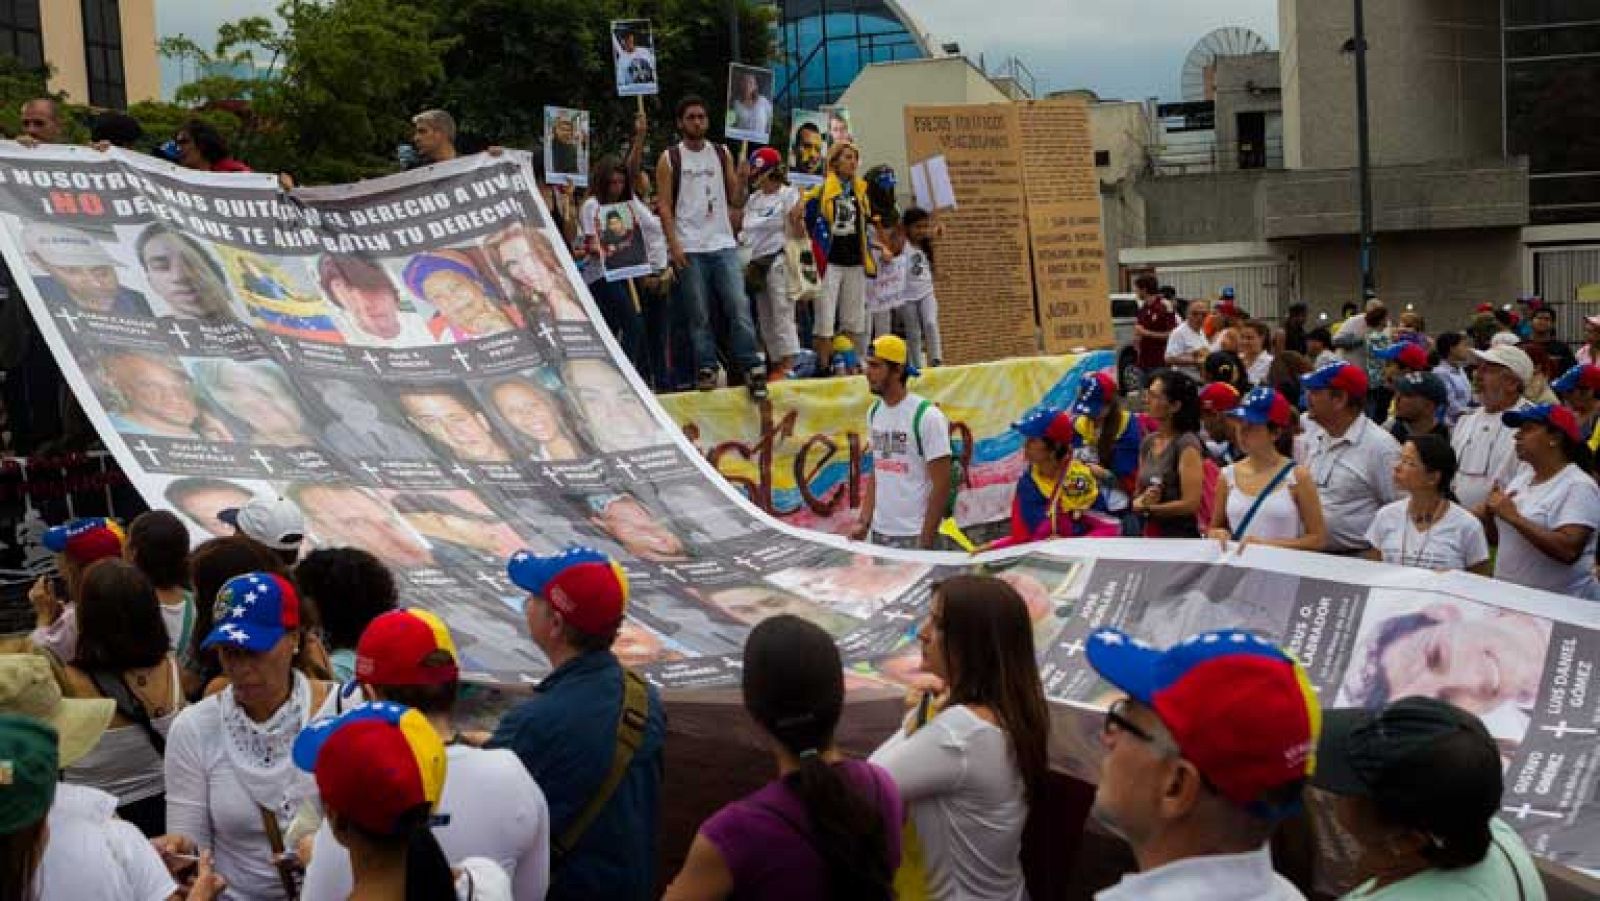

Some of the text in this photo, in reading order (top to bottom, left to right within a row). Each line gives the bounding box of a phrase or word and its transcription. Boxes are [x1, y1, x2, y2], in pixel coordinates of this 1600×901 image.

[350, 191, 451, 227] DERECHO
[454, 187, 472, 204] A
[188, 216, 235, 241] QUE
[236, 226, 268, 245] TE
[393, 226, 425, 247] TU
